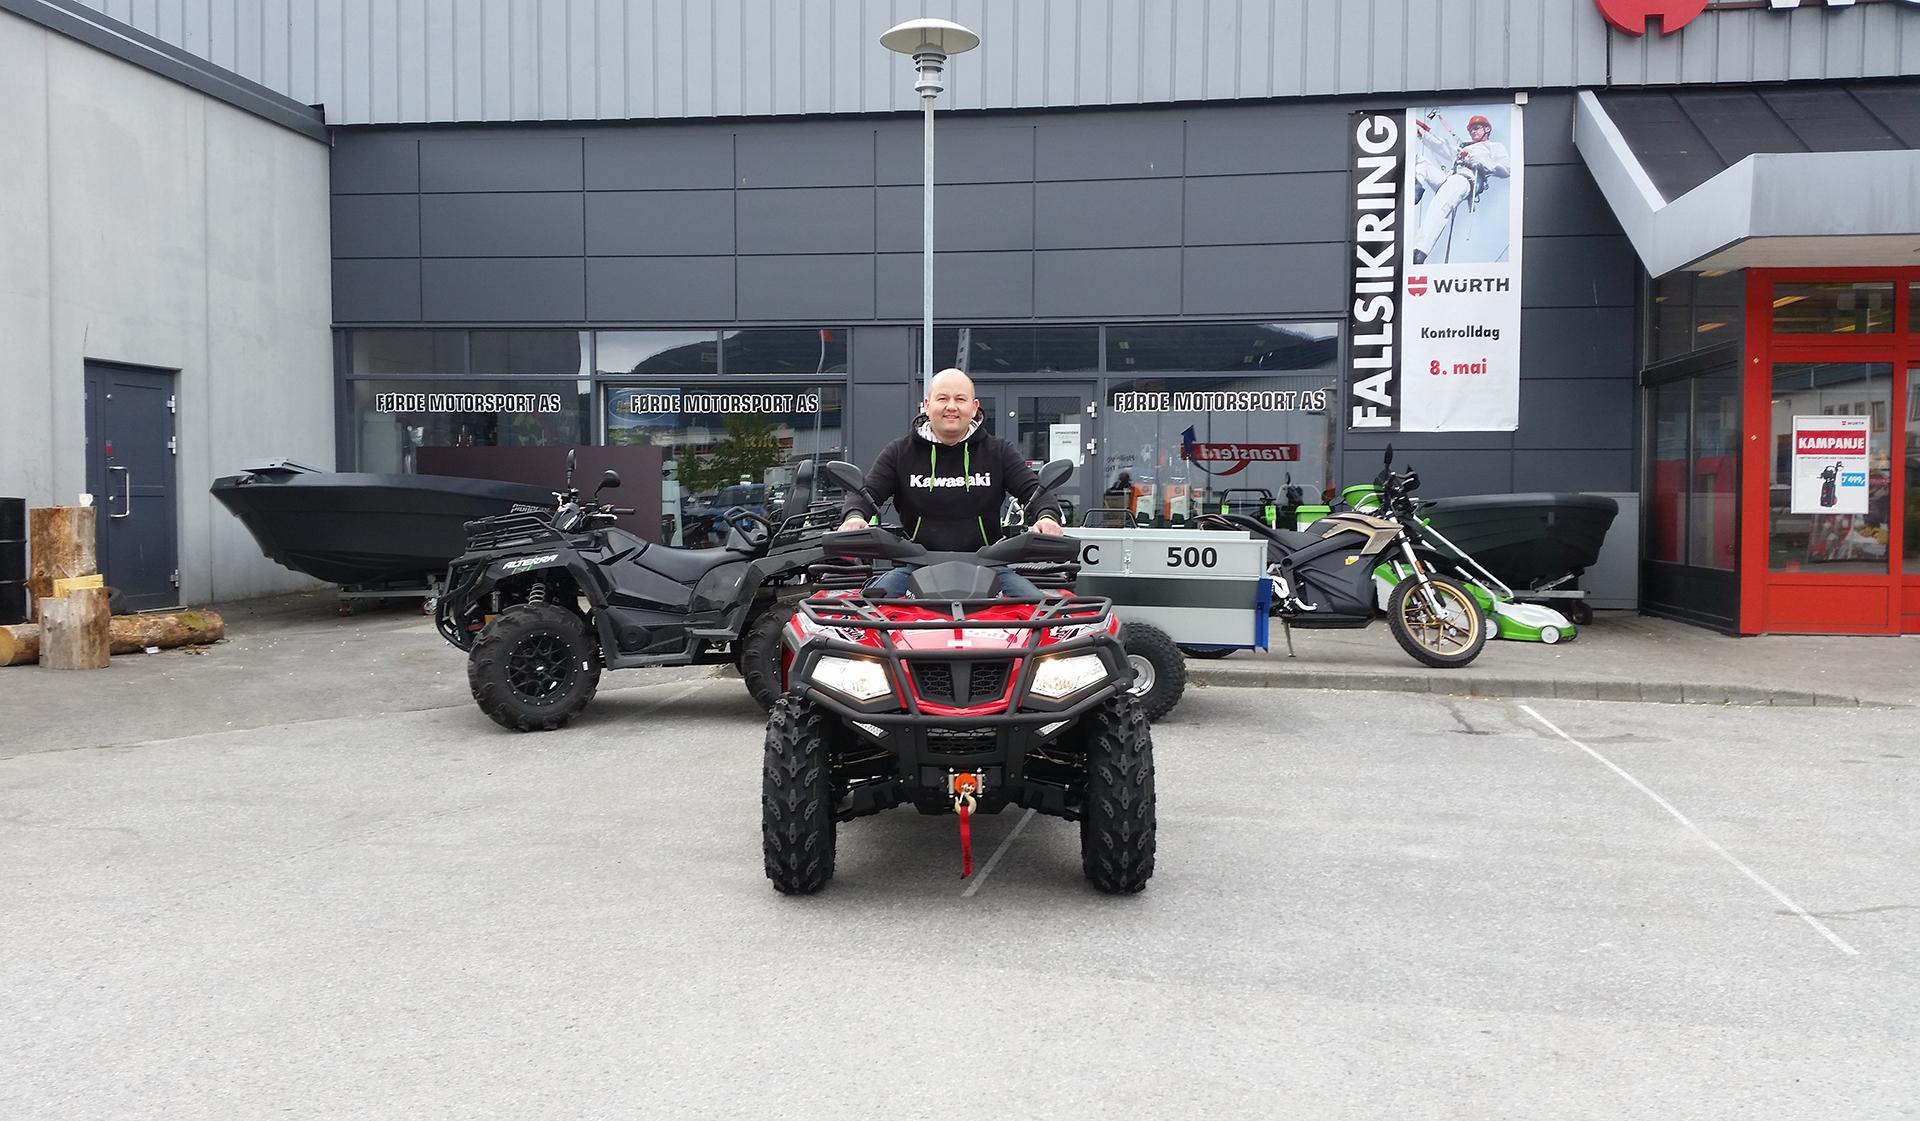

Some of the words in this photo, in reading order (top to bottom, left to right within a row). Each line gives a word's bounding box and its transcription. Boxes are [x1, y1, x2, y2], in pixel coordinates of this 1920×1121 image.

[1352, 114, 1398, 428] FALLSIKRING
[1433, 277, 1510, 294] WÜRTH
[1420, 325, 1500, 341] Kontrolldag
[1429, 359, 1448, 376] 8.
[1453, 358, 1487, 375] mai
[376, 392, 425, 413] FØRDE
[428, 393, 536, 413] MOTORSPORT
[538, 394, 561, 412] AS
[630, 393, 681, 415] FØRDE
[683, 394, 793, 414] MOTORSPORT
[795, 394, 819, 413] AS
[1114, 390, 1170, 413] FØRDE
[1173, 391, 1297, 412] MOTORSPORT
[1299, 390, 1327, 411] AS
[1798, 437, 1865, 450] KAMPANJE
[909, 472, 992, 488] Kawasaki
[502, 554, 559, 570] ALTERRA
[1077, 544, 1100, 565] C
[1166, 546, 1218, 568] 500
